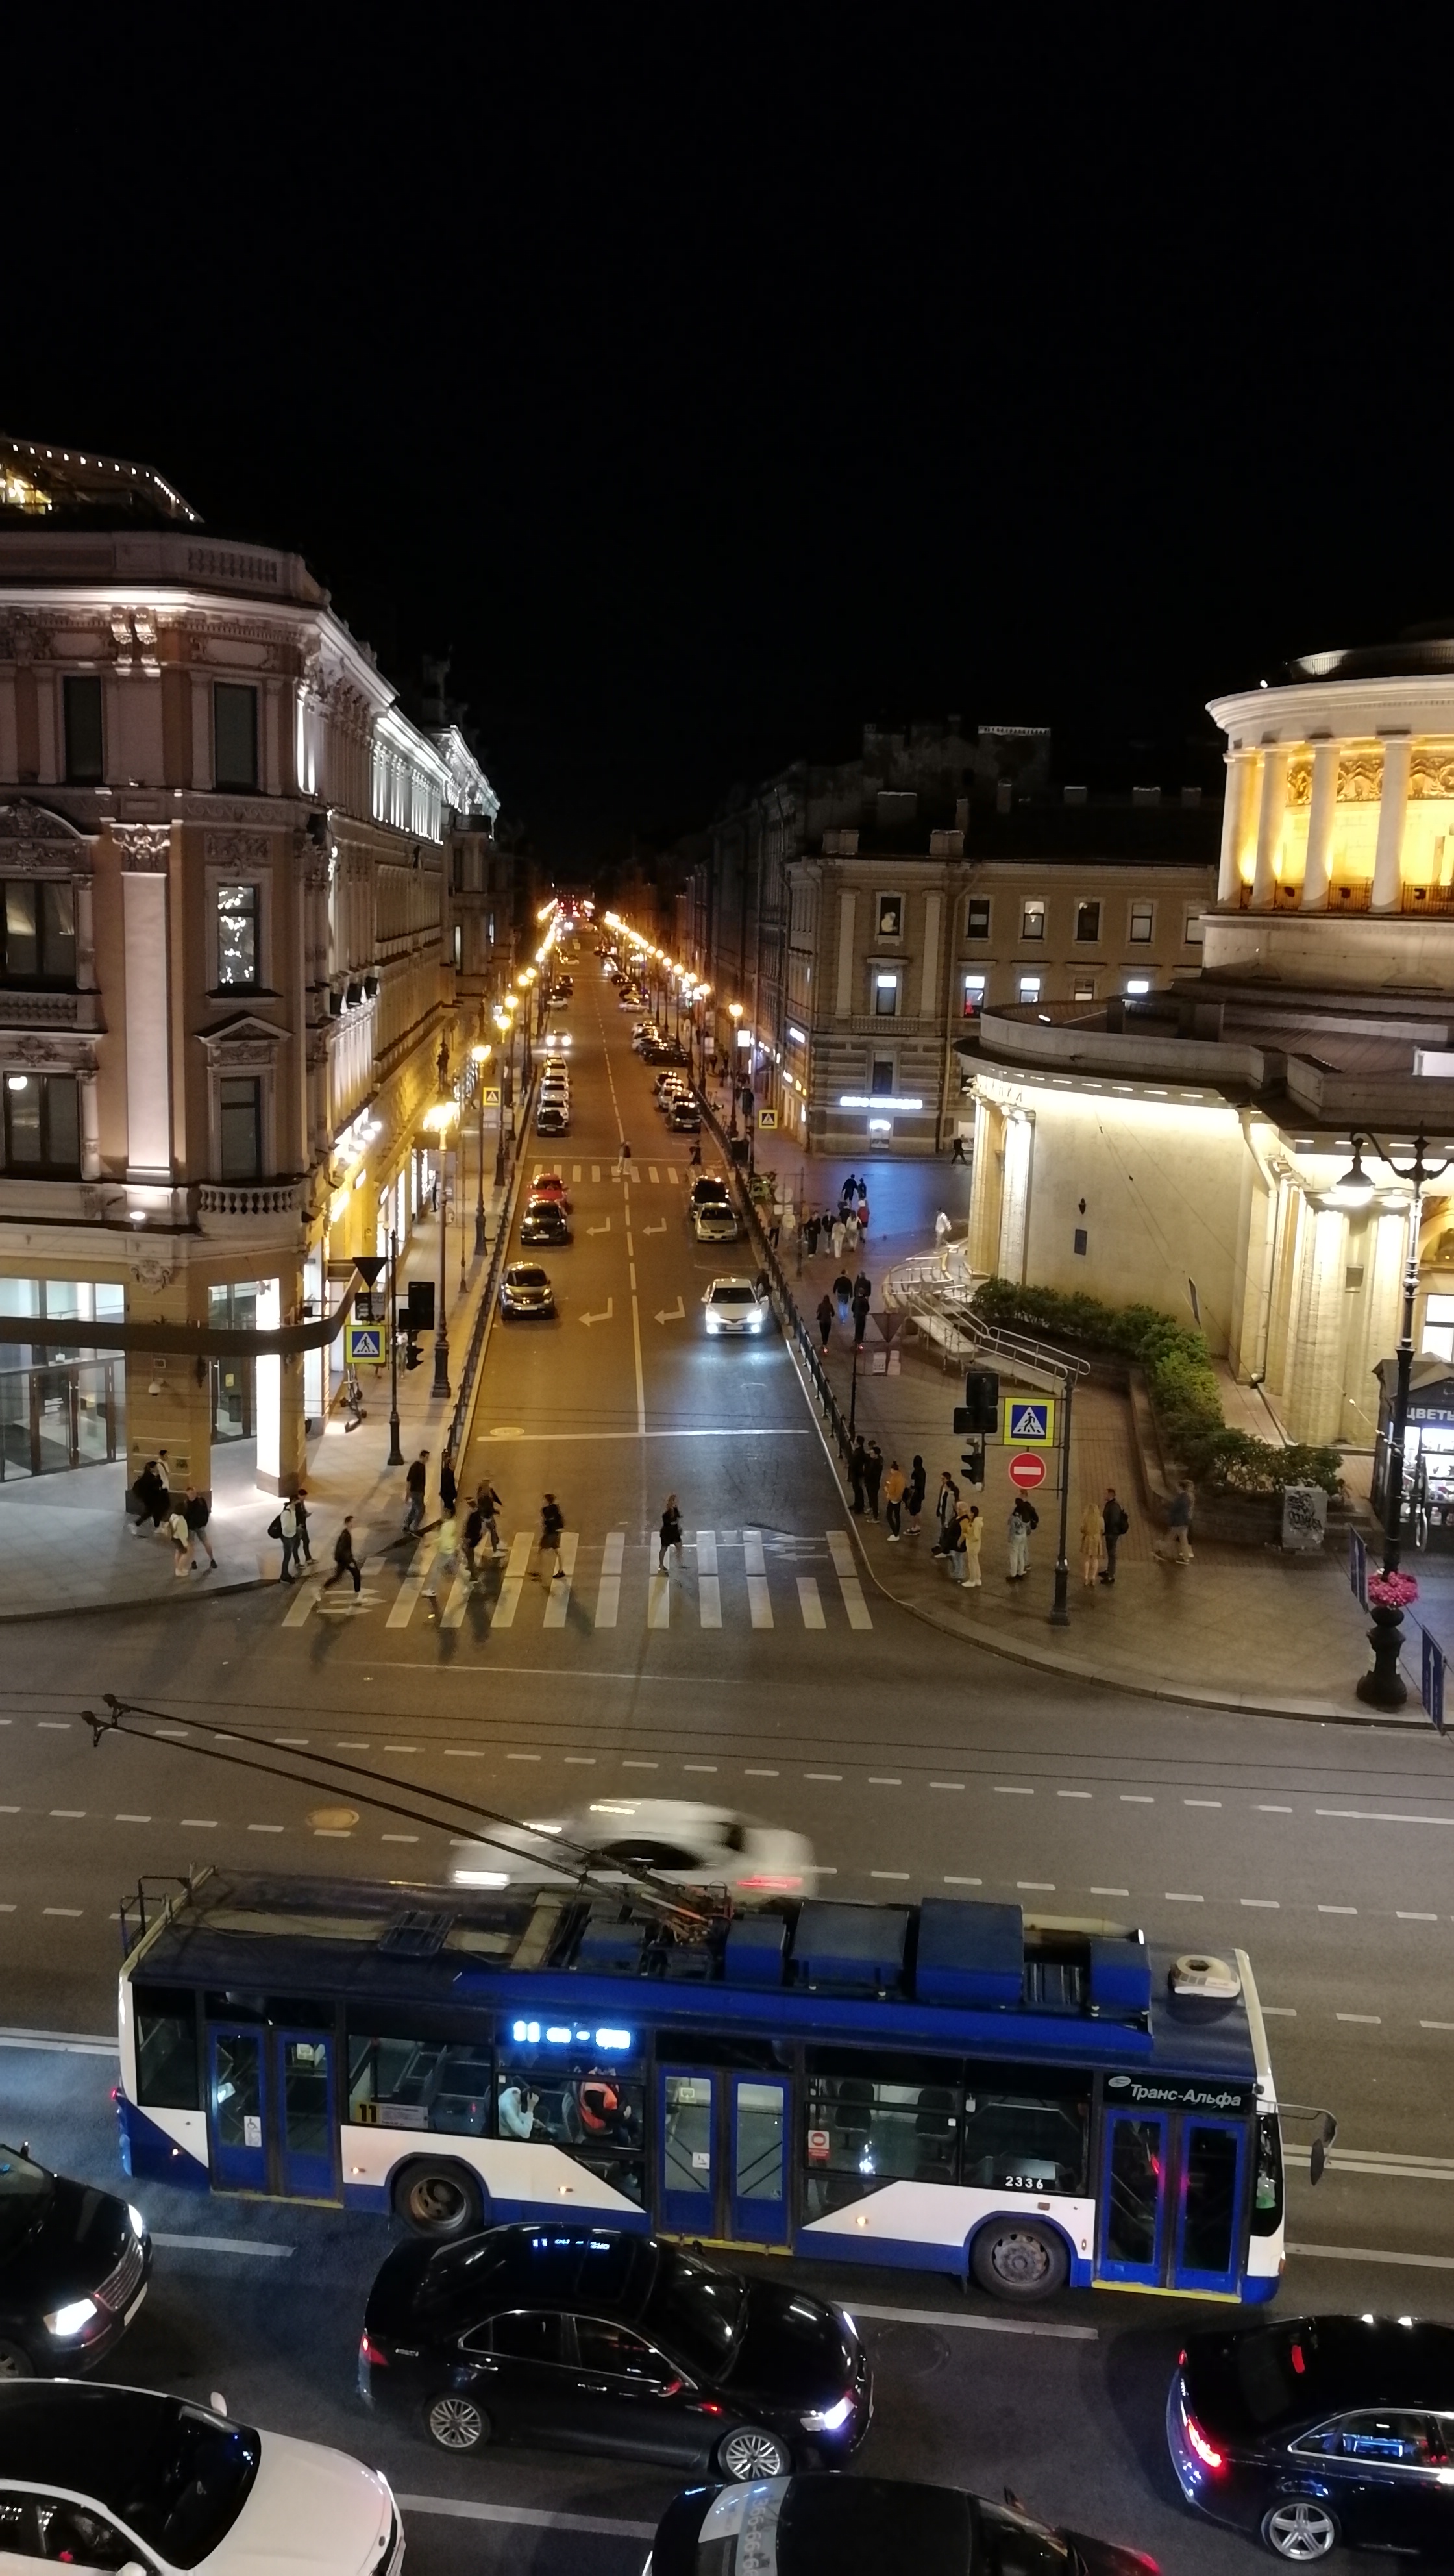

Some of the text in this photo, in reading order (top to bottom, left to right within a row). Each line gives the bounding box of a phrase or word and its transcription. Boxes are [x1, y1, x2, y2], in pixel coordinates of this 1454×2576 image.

[1130, 2083, 1242, 2109] Транс-Альфа
[359, 2103, 376, 2123] 11
[1005, 2175, 1044, 2190] 2336
